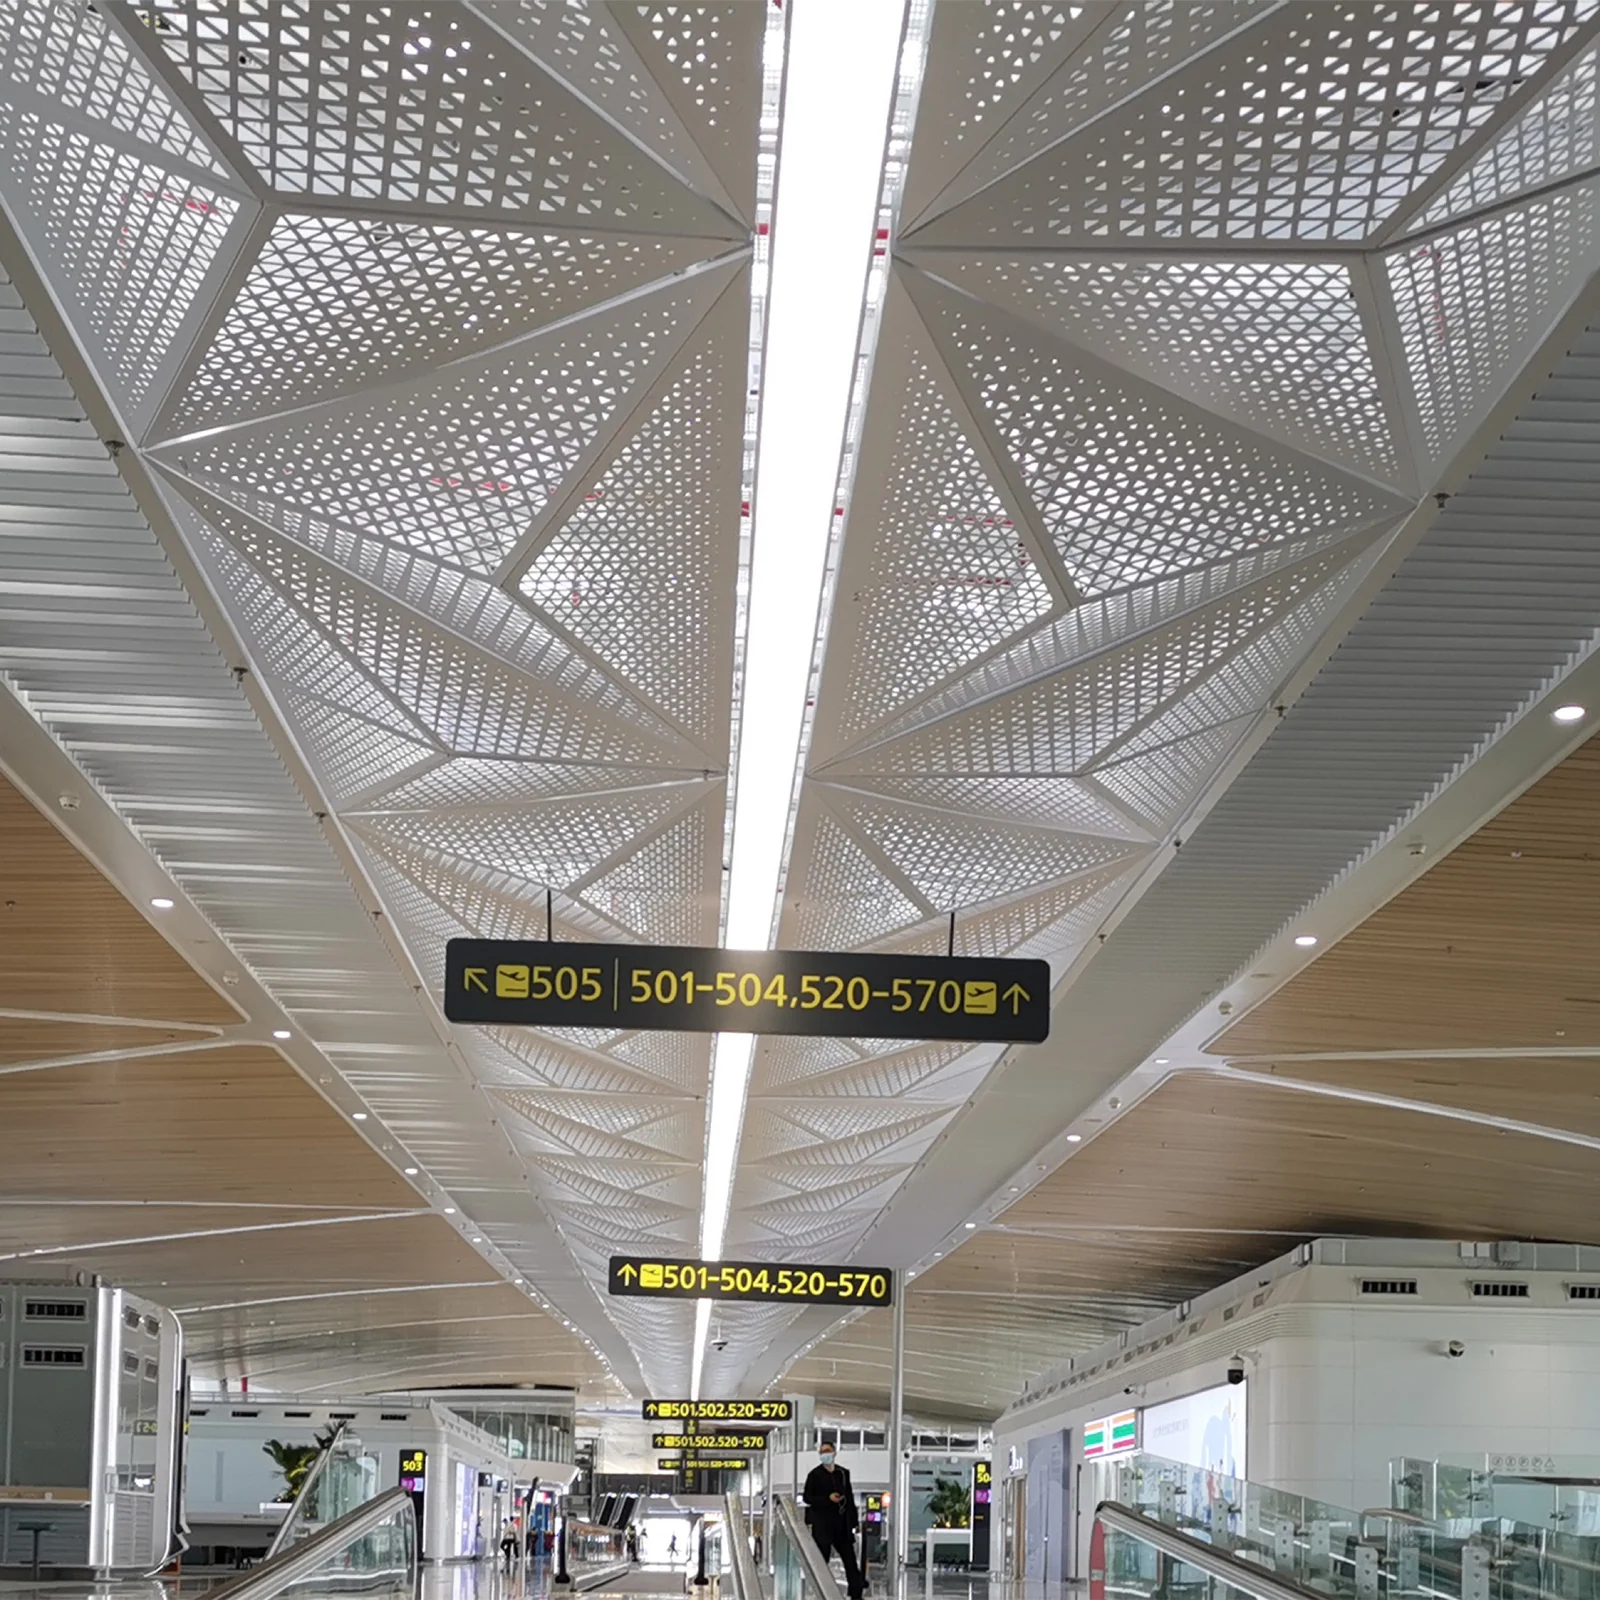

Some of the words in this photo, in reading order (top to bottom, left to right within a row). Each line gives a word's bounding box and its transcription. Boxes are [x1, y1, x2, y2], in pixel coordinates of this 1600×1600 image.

[531, 965, 602, 1002] 505
[630, 969, 962, 1014] 501-504,520-570
[663, 1265, 887, 1298] 501-504,520-570
[671, 1402, 788, 1418] 501,502,520-570
[403, 1460, 422, 1471] 503
